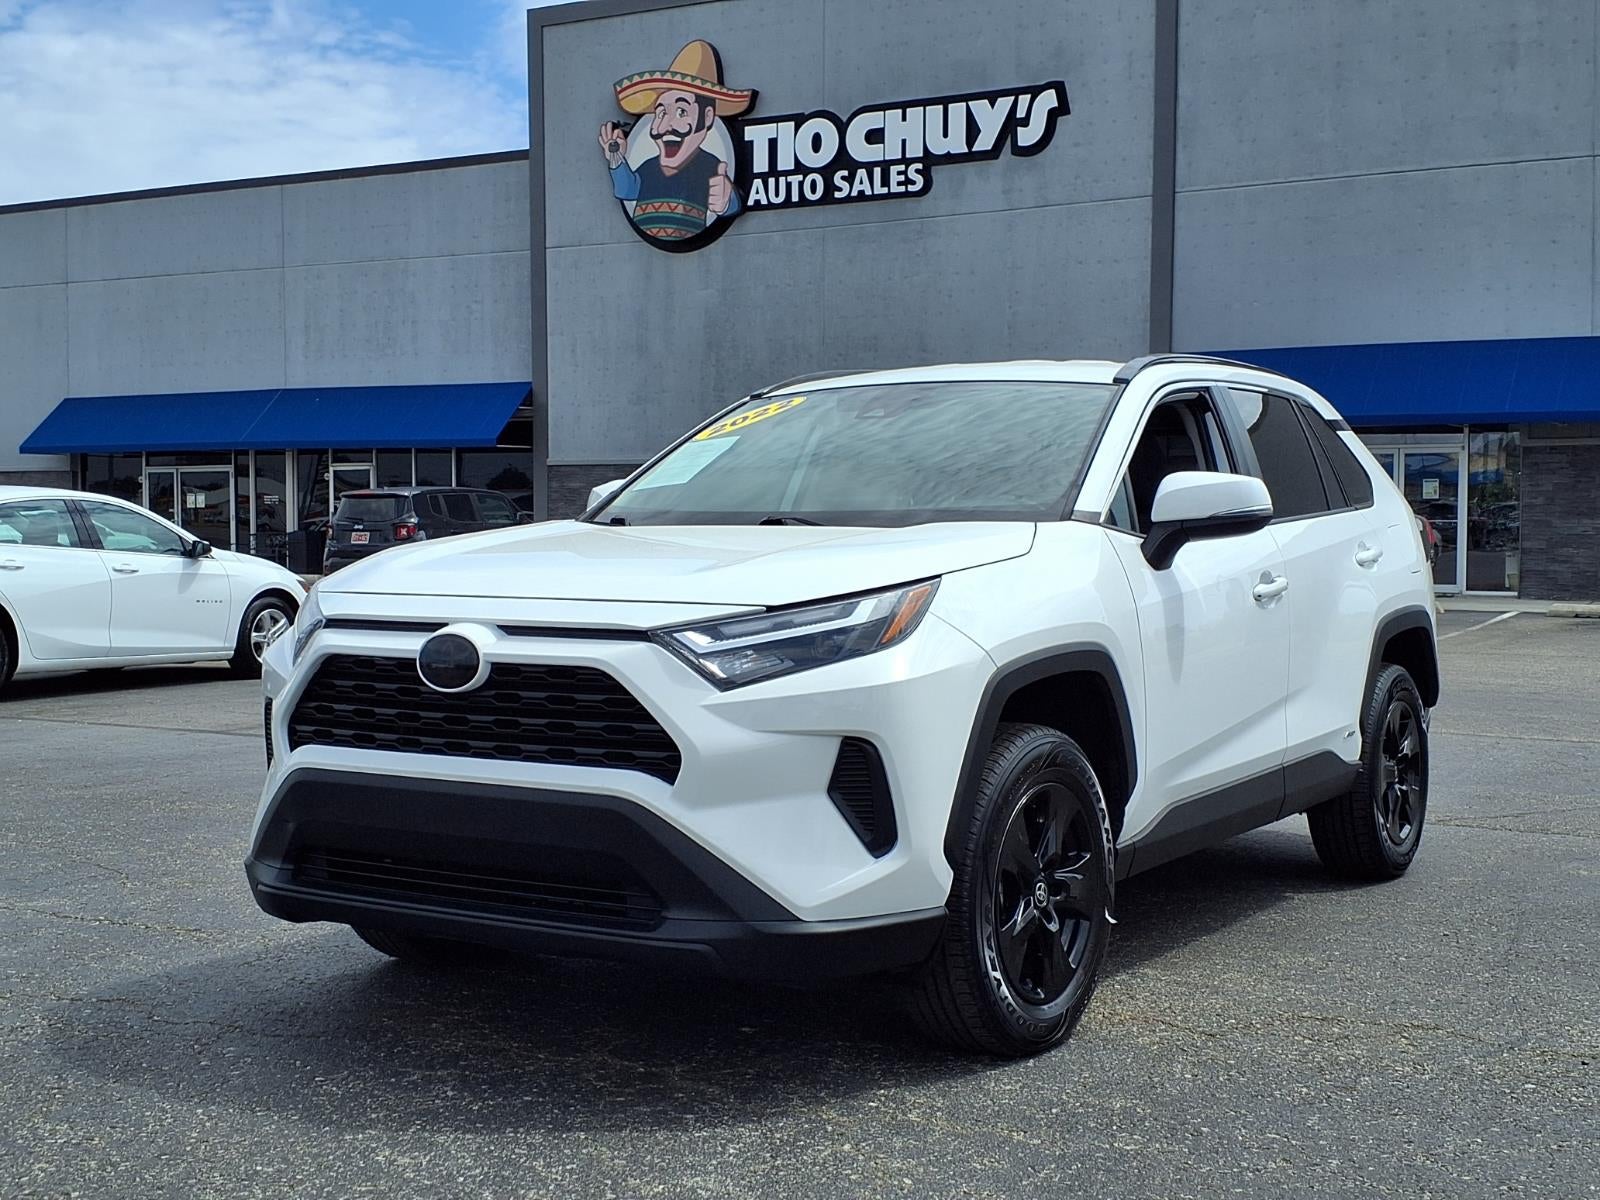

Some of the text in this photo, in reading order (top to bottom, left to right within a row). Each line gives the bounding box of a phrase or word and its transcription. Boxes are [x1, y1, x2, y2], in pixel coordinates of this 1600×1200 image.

[744, 88, 1058, 173] TIO CHUY'S
[747, 163, 924, 206] AUTO SALES
[706, 399, 796, 437] 2022
